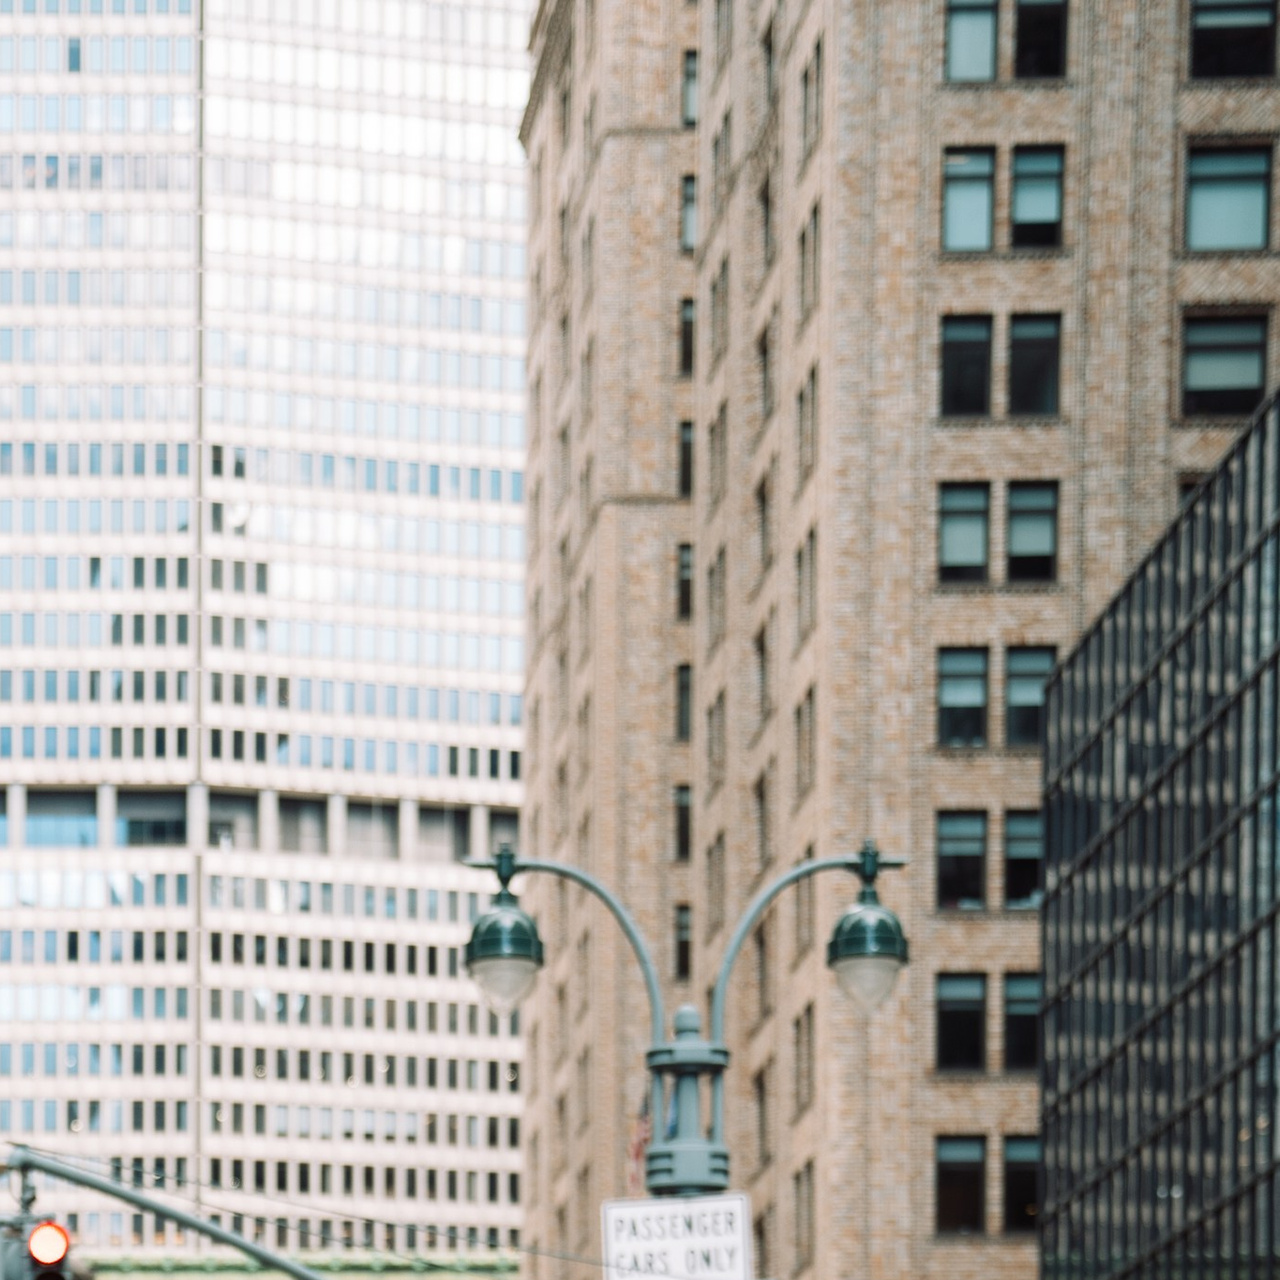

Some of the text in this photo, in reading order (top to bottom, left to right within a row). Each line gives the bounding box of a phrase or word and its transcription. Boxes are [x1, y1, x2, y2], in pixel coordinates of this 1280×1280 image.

[615, 1212, 735, 1242] PASSENGER
[615, 1247, 737, 1278] CARS ONLY
